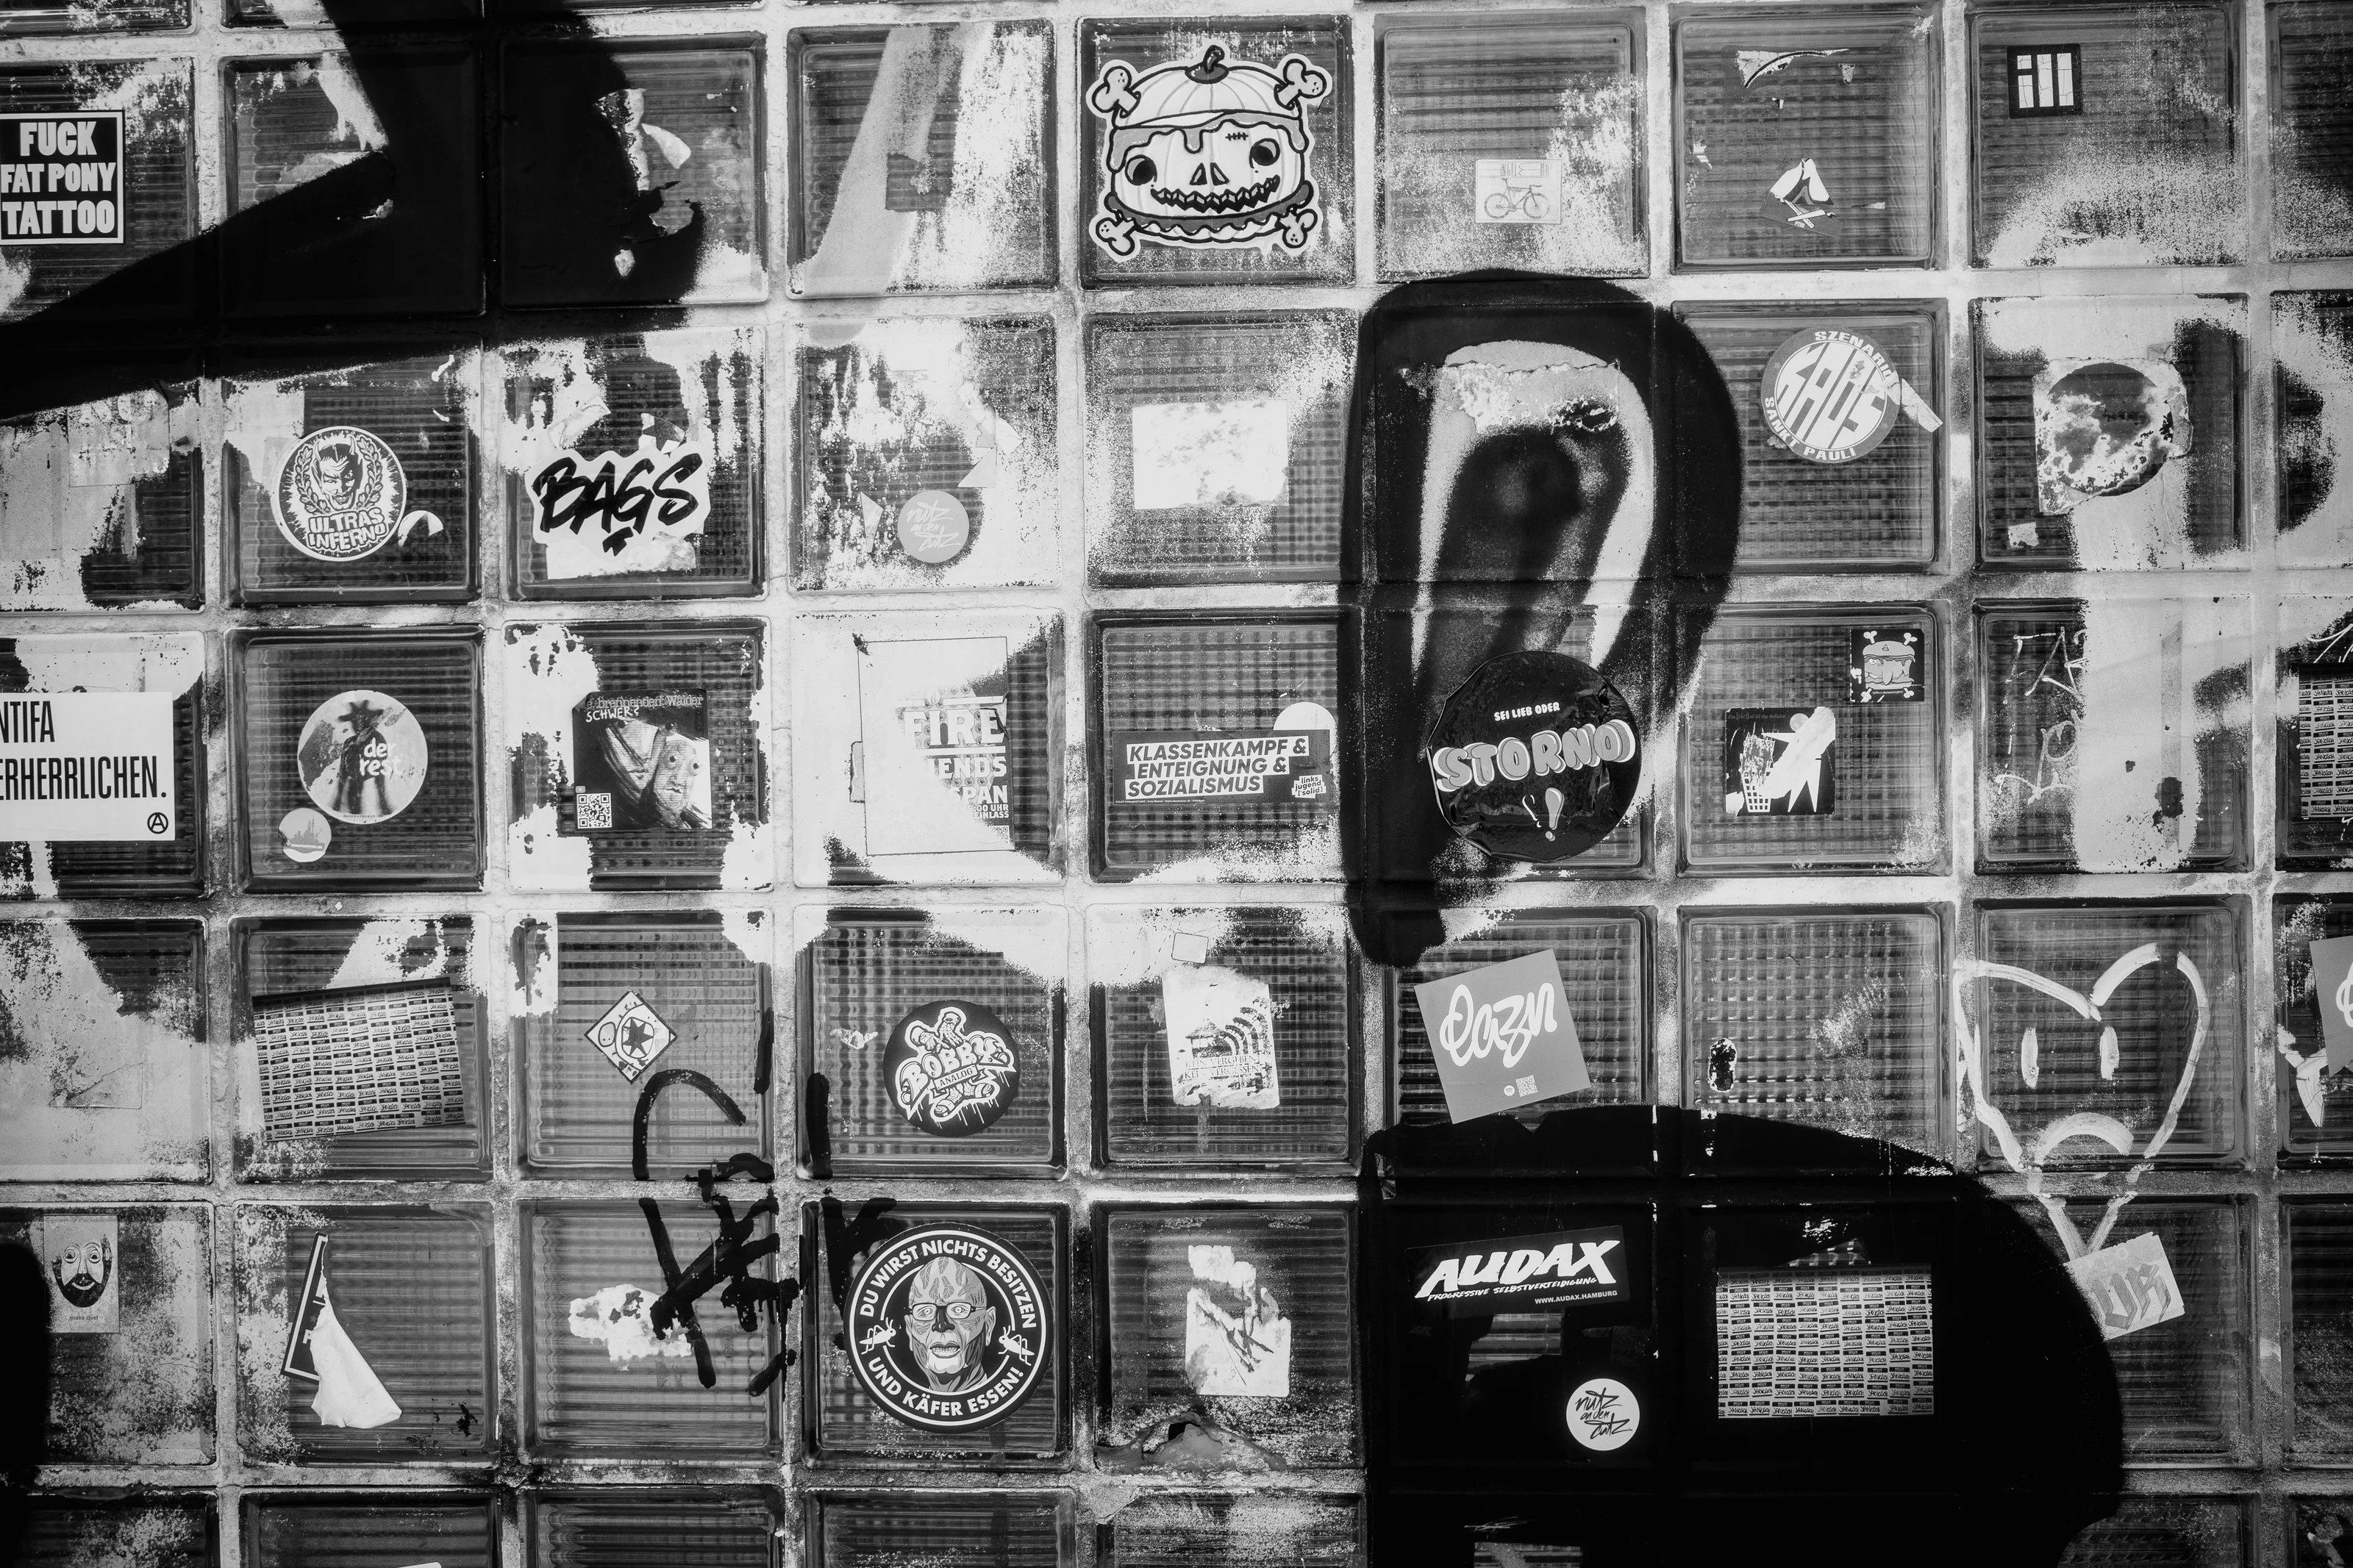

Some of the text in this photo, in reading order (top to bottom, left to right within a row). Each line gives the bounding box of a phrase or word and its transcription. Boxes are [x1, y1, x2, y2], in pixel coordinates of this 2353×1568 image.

[20, 121, 97, 156] FUCK
[0, 162, 116, 193] FAT PONY
[2, 200, 115, 235] TATTOO
[1765, 397, 1857, 461] SANKT PAULI
[532, 453, 703, 535] BAGS
[309, 507, 385, 534] ULTRAS
[309, 523, 387, 550] INFERNO
[586, 705, 639, 723] SCHWER?
[1493, 702, 1560, 721] SEI LIEB ODER
[904, 709, 1005, 745] FIRE
[364, 737, 396, 758] der
[1129, 737, 1307, 762] KLASSENKAMPF &
[1433, 719, 1635, 792] STORNO
[360, 753, 404, 776] rest
[934, 756, 1007, 779] ENDS
[1138, 756, 1287, 779] ENTEIGNUNG &
[958, 785, 1008, 803] PAN
[1128, 776, 1261, 798] SOZIALISMUS
[1295, 779, 1321, 792] jugend
[990, 803, 1009, 812] UHR
[900, 1035, 1010, 1101] BOBBY
[939, 1067, 974, 1087] ANALOG
[1415, 1240, 1621, 1299] AUDAX
[860, 1239, 1037, 1328] DU WIRST NICHTS BESITZEN
[1427, 1277, 1598, 1302] PROGRESSIVE SELBSTVERTEIDIGUNG
[1535, 1290, 1618, 1304] WWW.AUDAX.HAMBURG
[868, 1357, 1024, 1417] UND KÄFER ESSEN!
